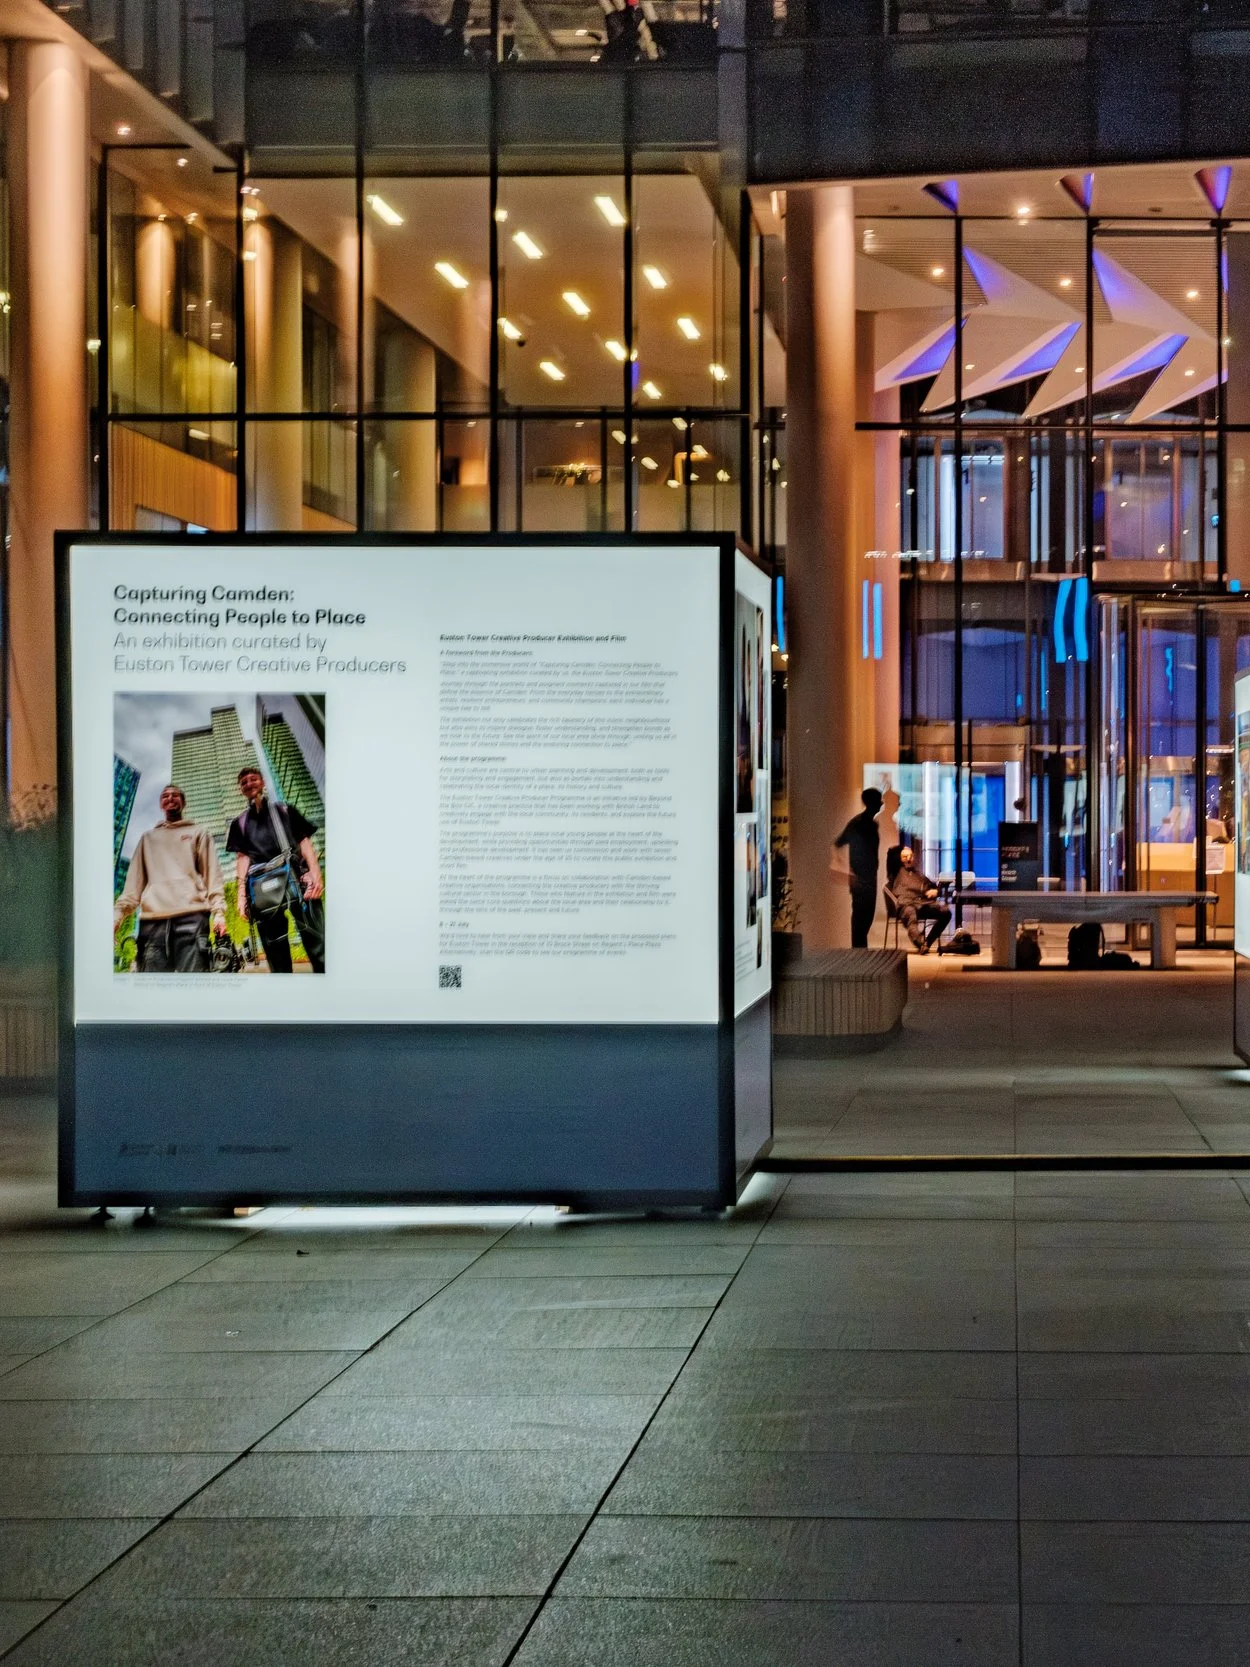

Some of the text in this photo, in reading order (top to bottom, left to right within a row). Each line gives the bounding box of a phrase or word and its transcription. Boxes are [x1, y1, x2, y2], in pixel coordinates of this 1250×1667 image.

[113, 584, 294, 605] Capturing Camden:
[113, 608, 366, 628] Connecting People to Place
[114, 632, 327, 652] An exhibition curated by
[114, 655, 407, 672] Euston Tower Creative Producers
